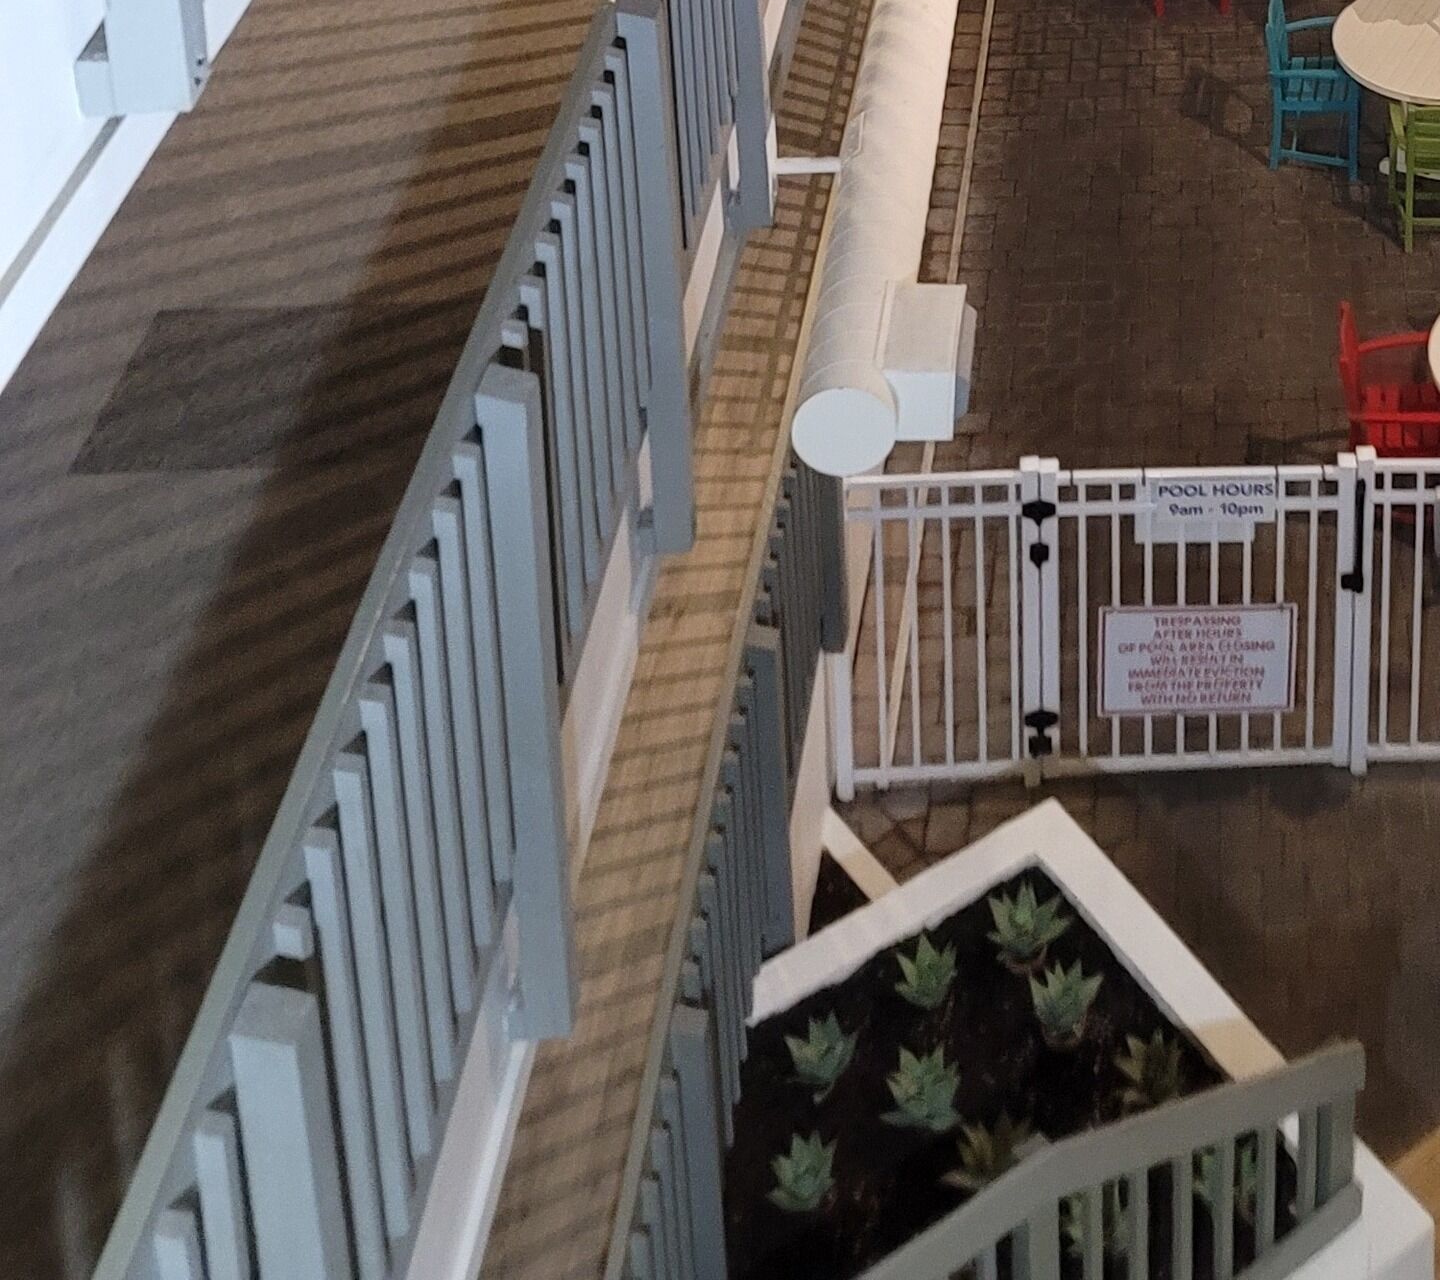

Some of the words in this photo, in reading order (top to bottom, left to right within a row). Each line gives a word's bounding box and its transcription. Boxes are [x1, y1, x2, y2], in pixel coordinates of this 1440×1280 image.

[1158, 484, 1207, 497] POOL
[1212, 483, 1274, 496] HOURS
[1169, 503, 1204, 516] 9am
[1220, 502, 1264, 517] 10pm
[1154, 616, 1241, 627] TRESPASSING
[1153, 630, 1192, 640] AFTER
[1195, 628, 1243, 639] HOURS
[1179, 642, 1214, 652] AREA
[1218, 640, 1275, 652] CLOSING
[1199, 692, 1252, 704] RETURN
